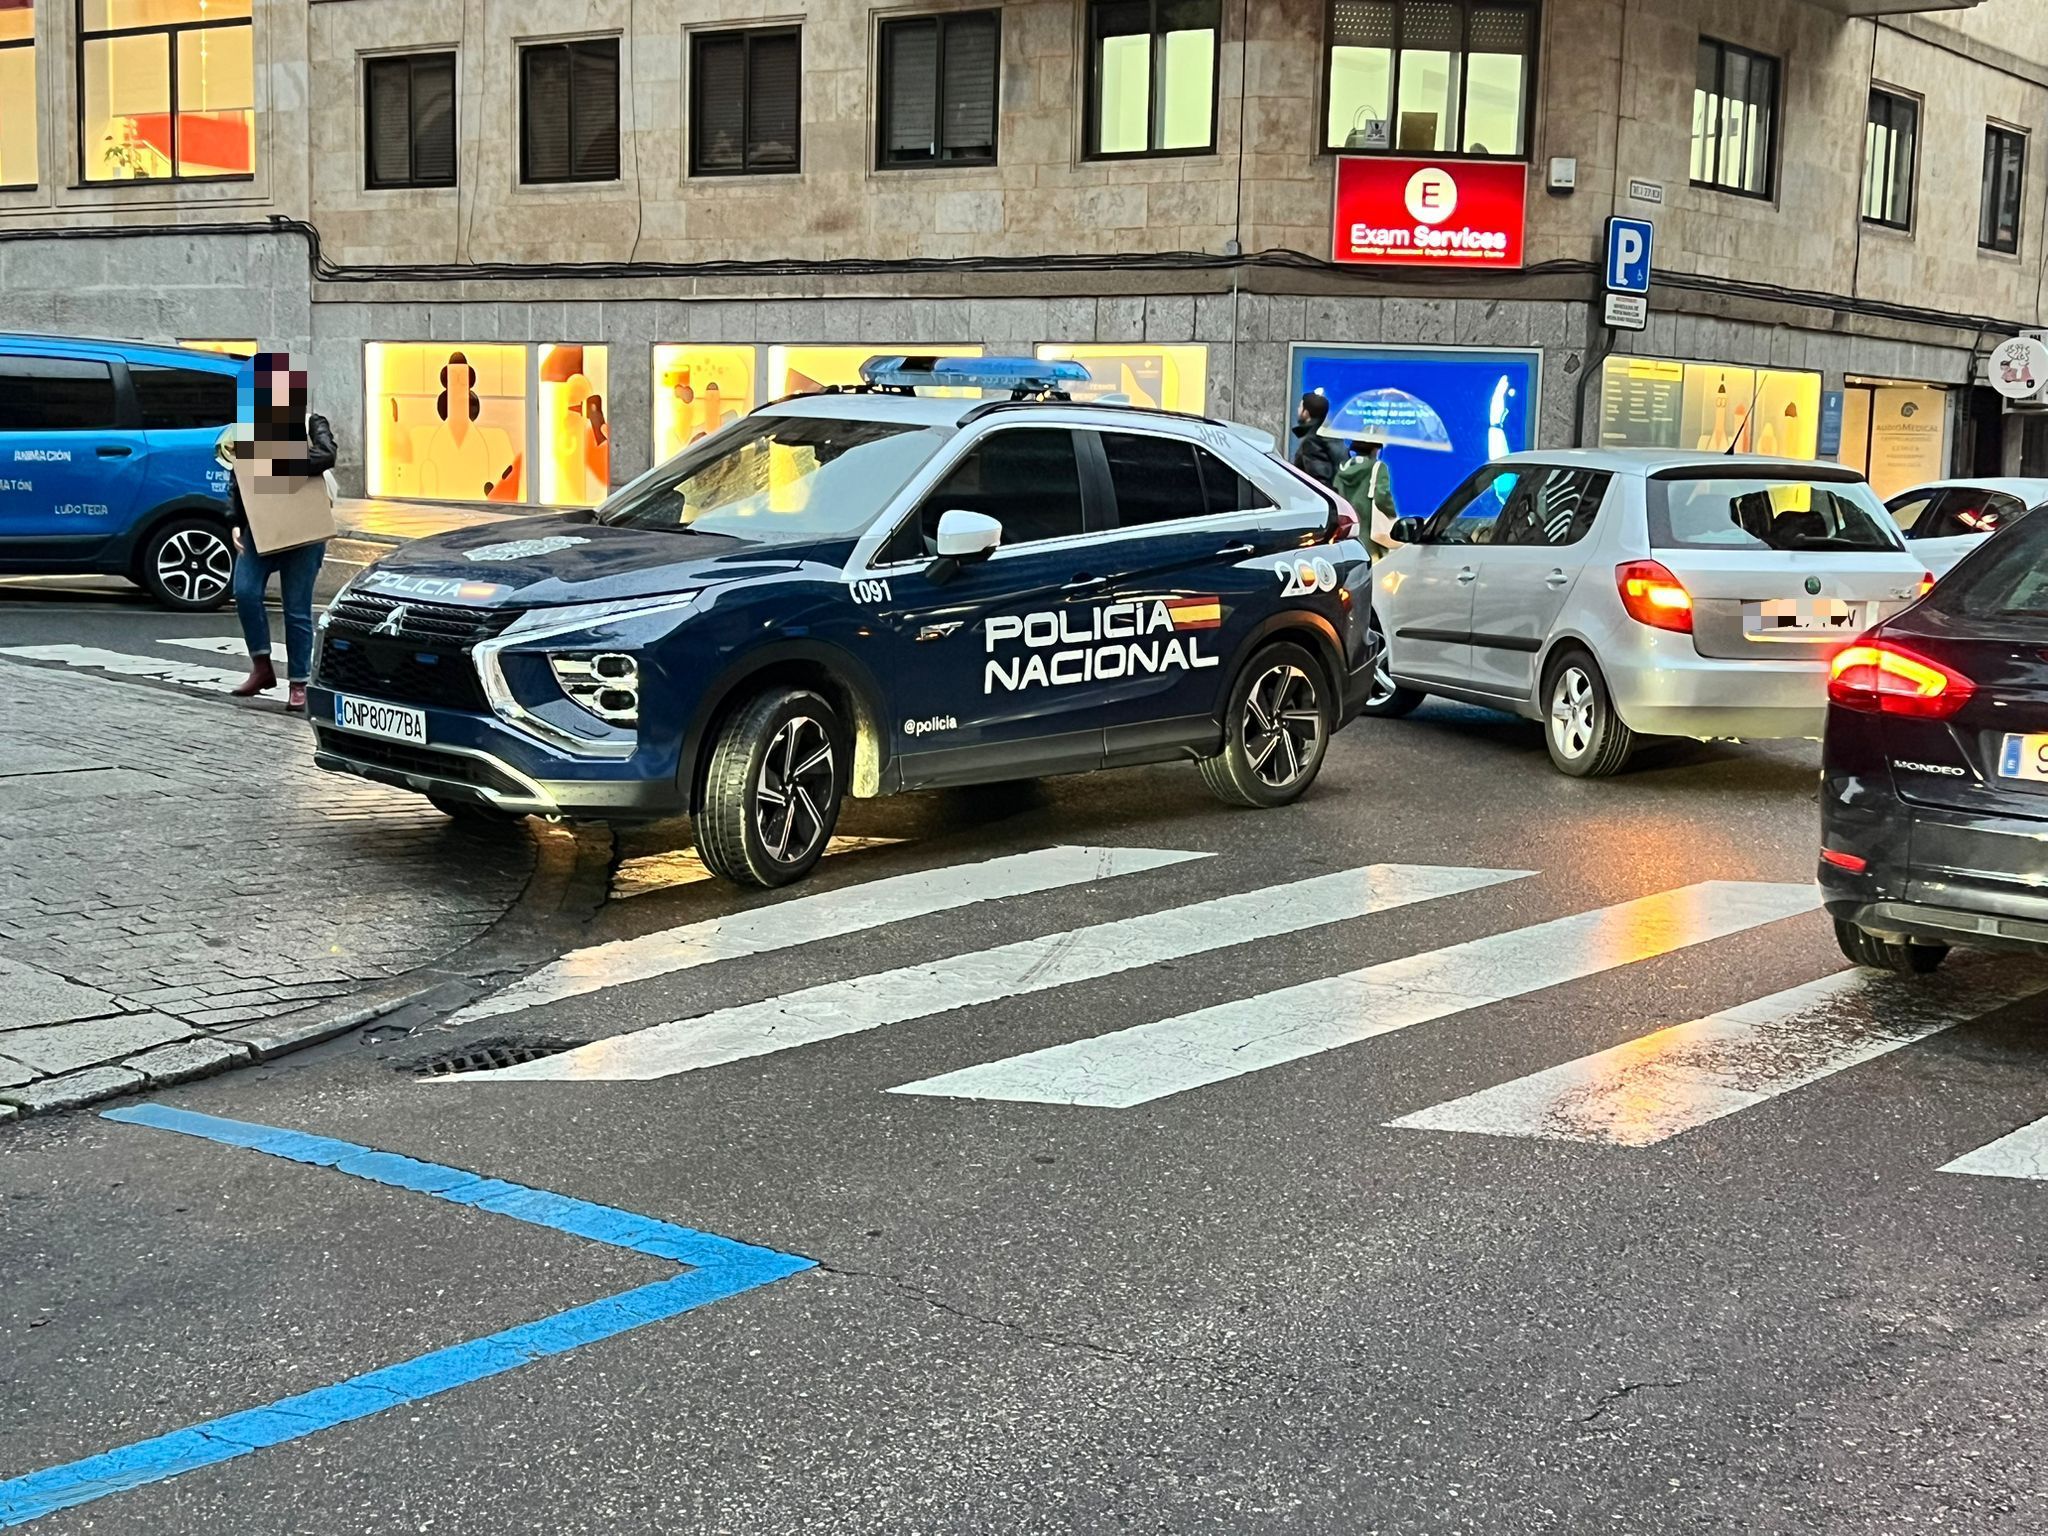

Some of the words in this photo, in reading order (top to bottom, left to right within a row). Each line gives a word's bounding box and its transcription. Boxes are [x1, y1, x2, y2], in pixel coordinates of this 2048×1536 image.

[1421, 182, 1441, 208] E
[1350, 223, 1410, 246] Exam
[1413, 225, 1507, 249] Services
[1616, 228, 1643, 285] P
[14, 449, 71, 461] ANIMACIÓN
[1274, 556, 1337, 597] 200
[984, 637, 1219, 694] NACIONAL
[343, 700, 423, 739] CNP8077BA
[1894, 760, 1965, 776] MONDEO
